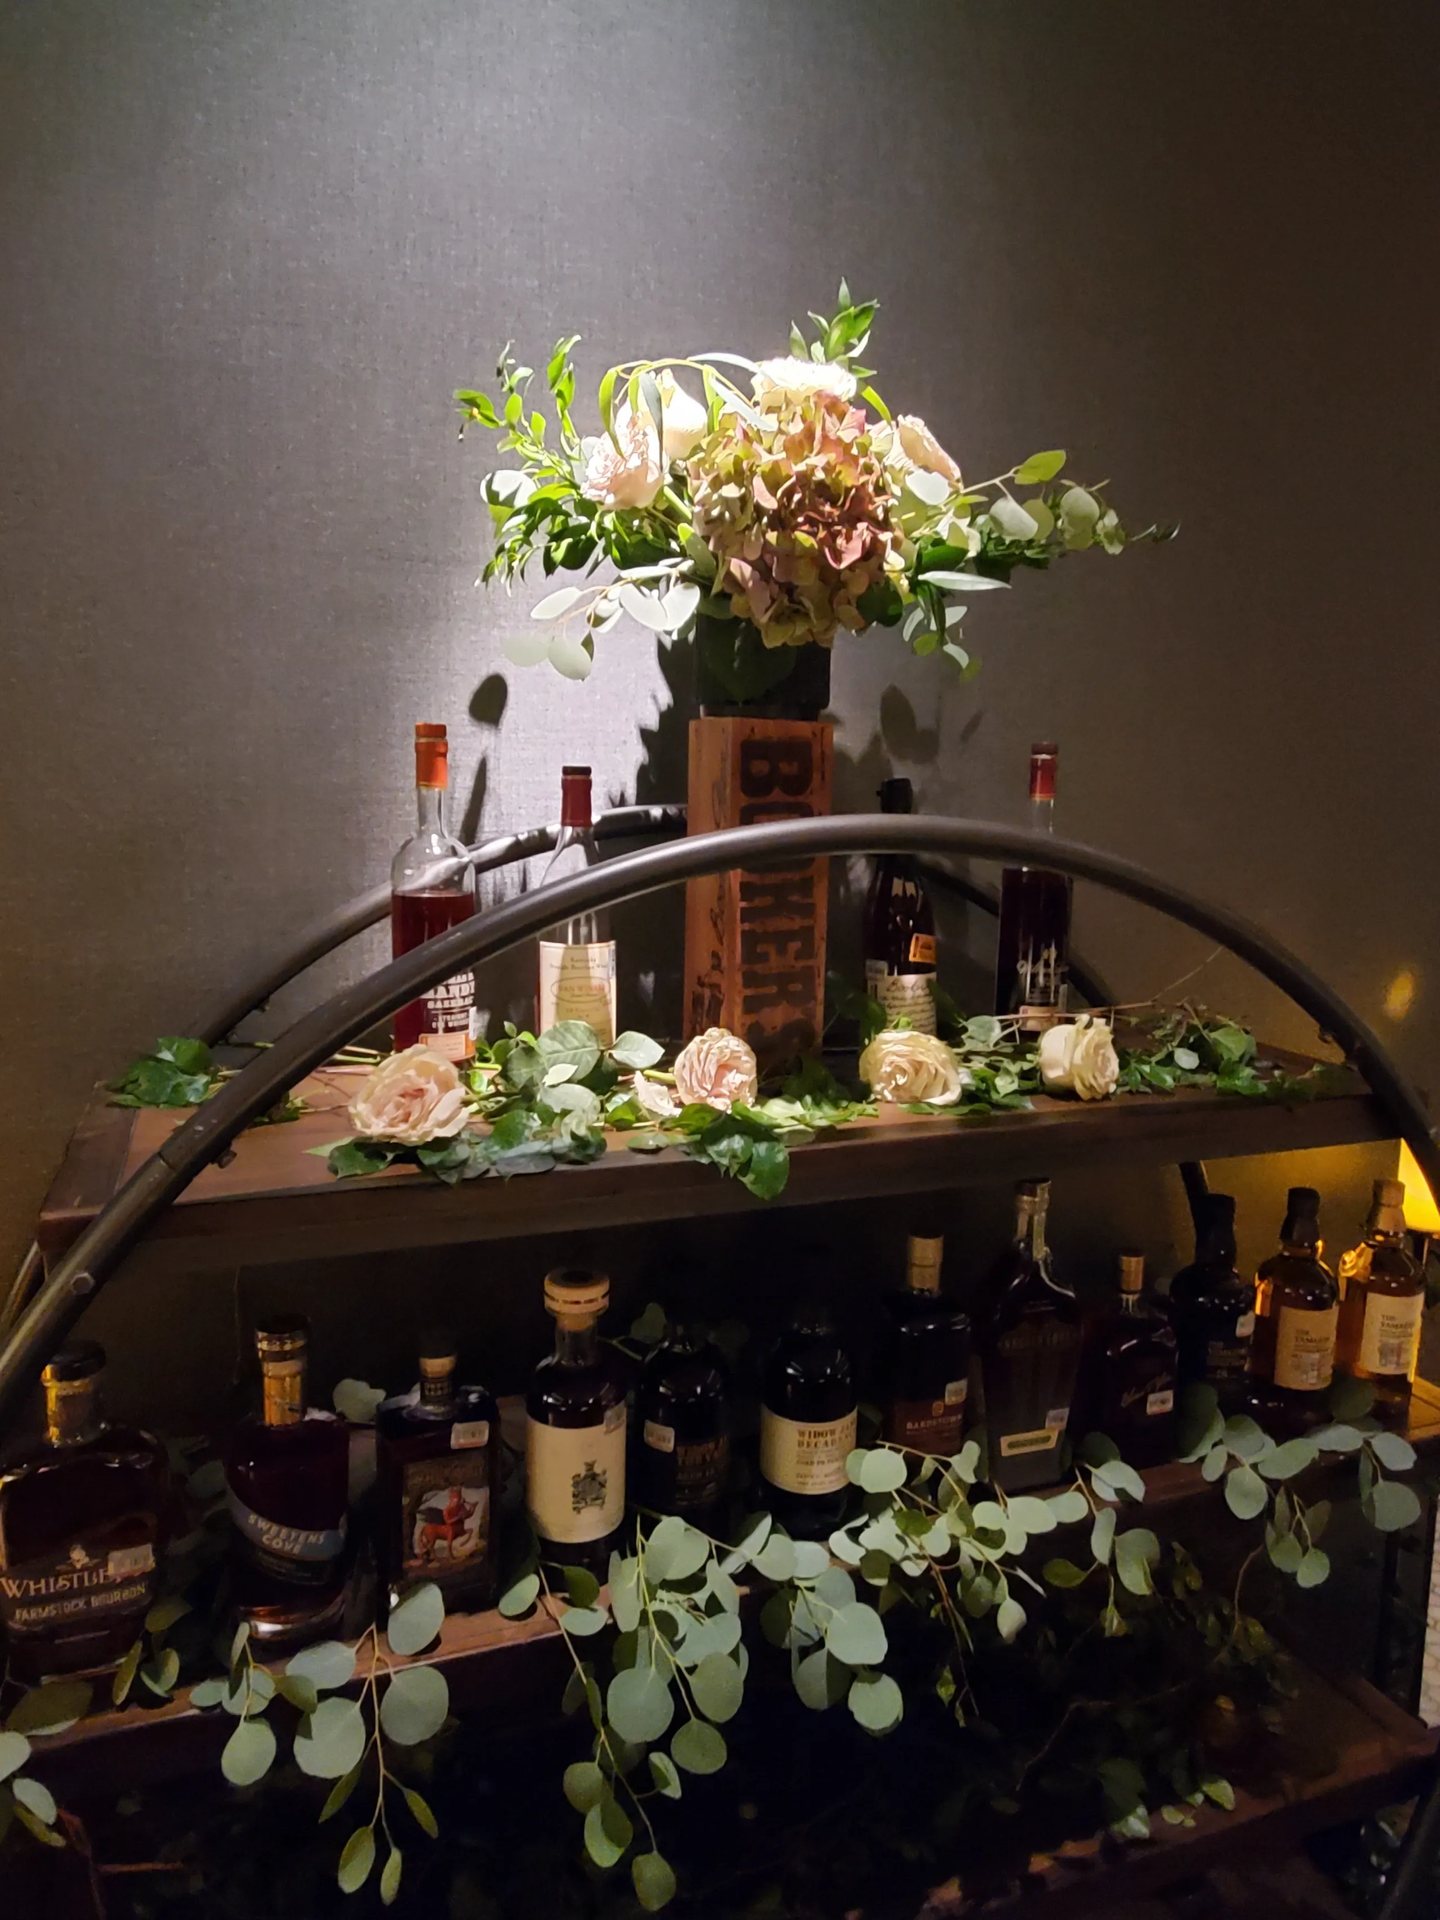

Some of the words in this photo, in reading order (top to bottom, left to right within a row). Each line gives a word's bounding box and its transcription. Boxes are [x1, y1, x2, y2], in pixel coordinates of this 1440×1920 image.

[739, 738, 816, 1068] BOKERS
[248, 1513, 327, 1545] SWEETENS
[262, 1534, 303, 1555] COVE
[0, 1566, 122, 1600] WHISTLE
[14, 1600, 85, 1623] FARMSTOCK
[90, 1582, 146, 1608] BOURBON
